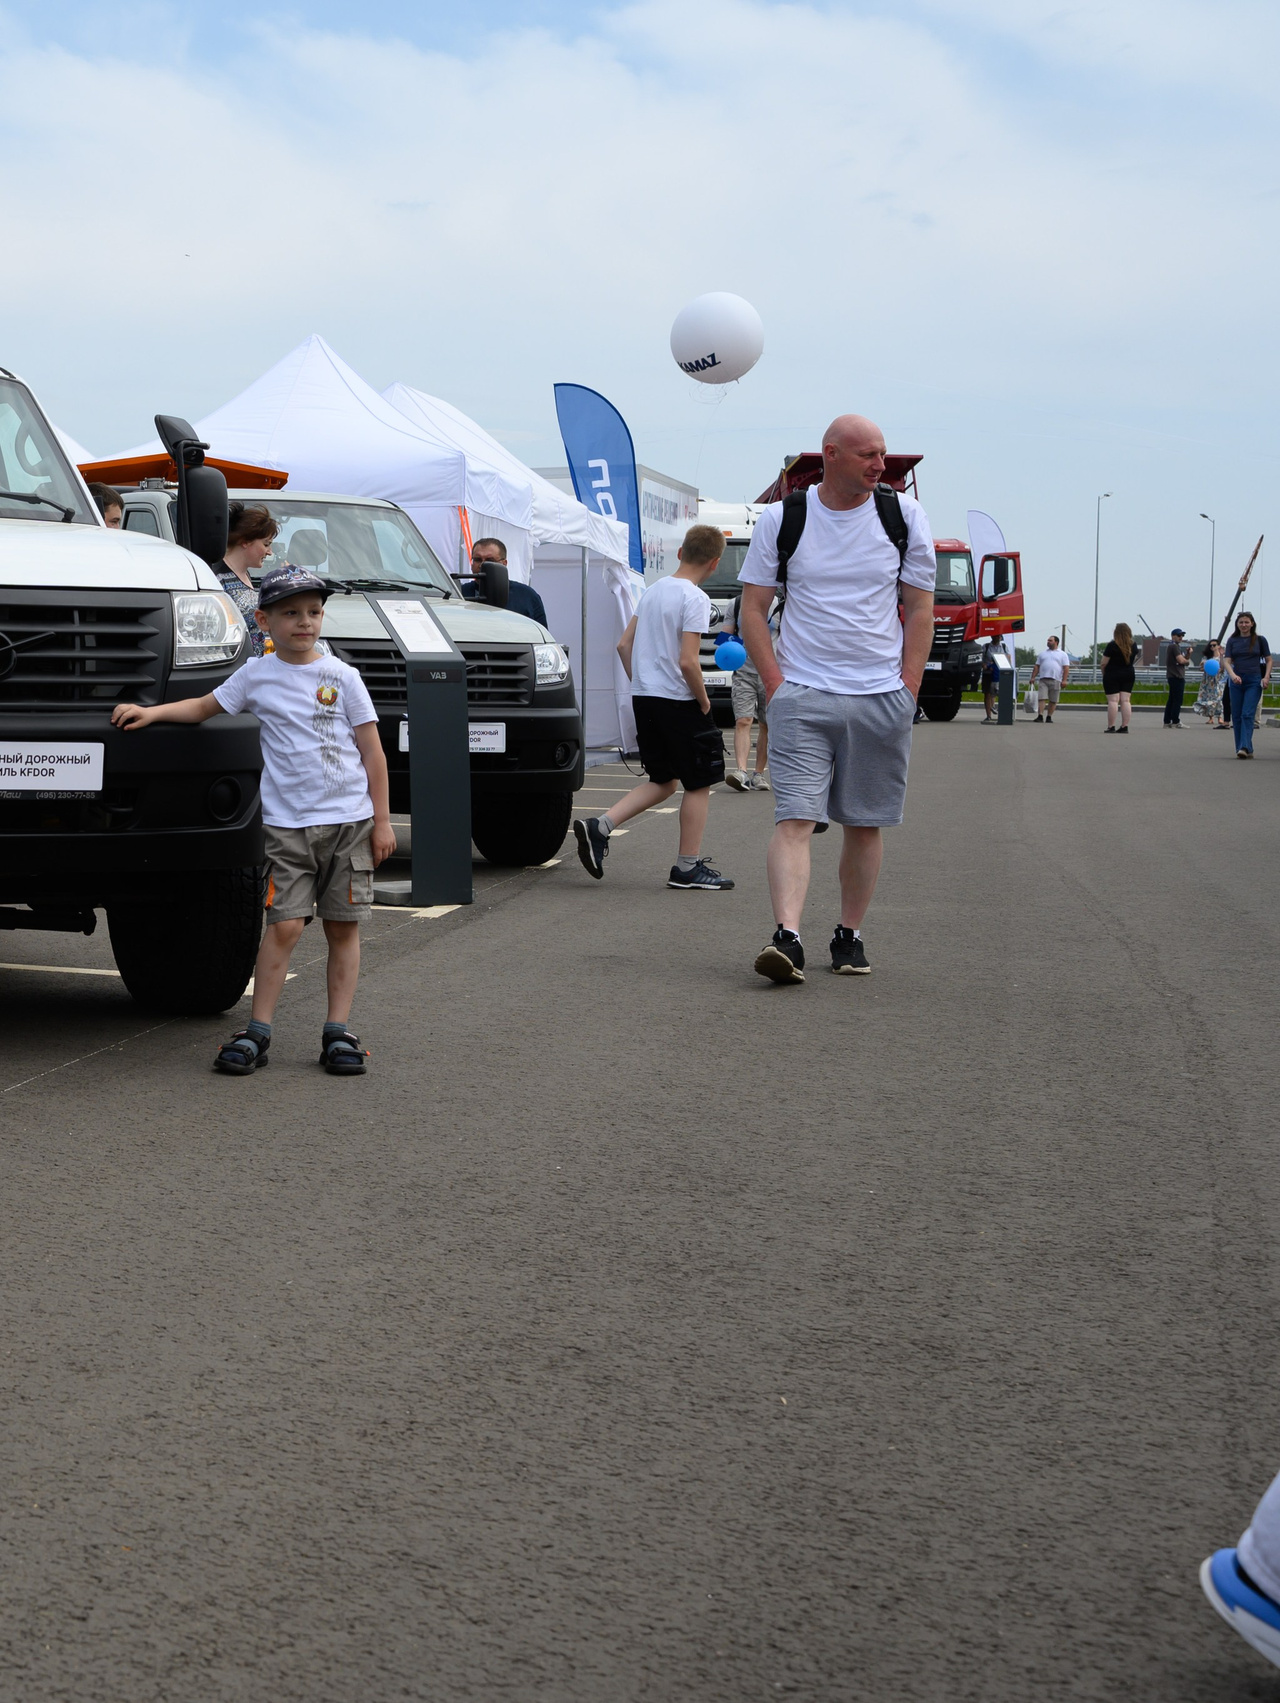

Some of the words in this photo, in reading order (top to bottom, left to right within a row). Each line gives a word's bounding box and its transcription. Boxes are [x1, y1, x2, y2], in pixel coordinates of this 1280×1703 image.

[430, 671, 447, 680] УАЗ
[25, 753, 91, 765] ДОРОЖНЫЙ
[19, 768, 56, 778] KFDOR
